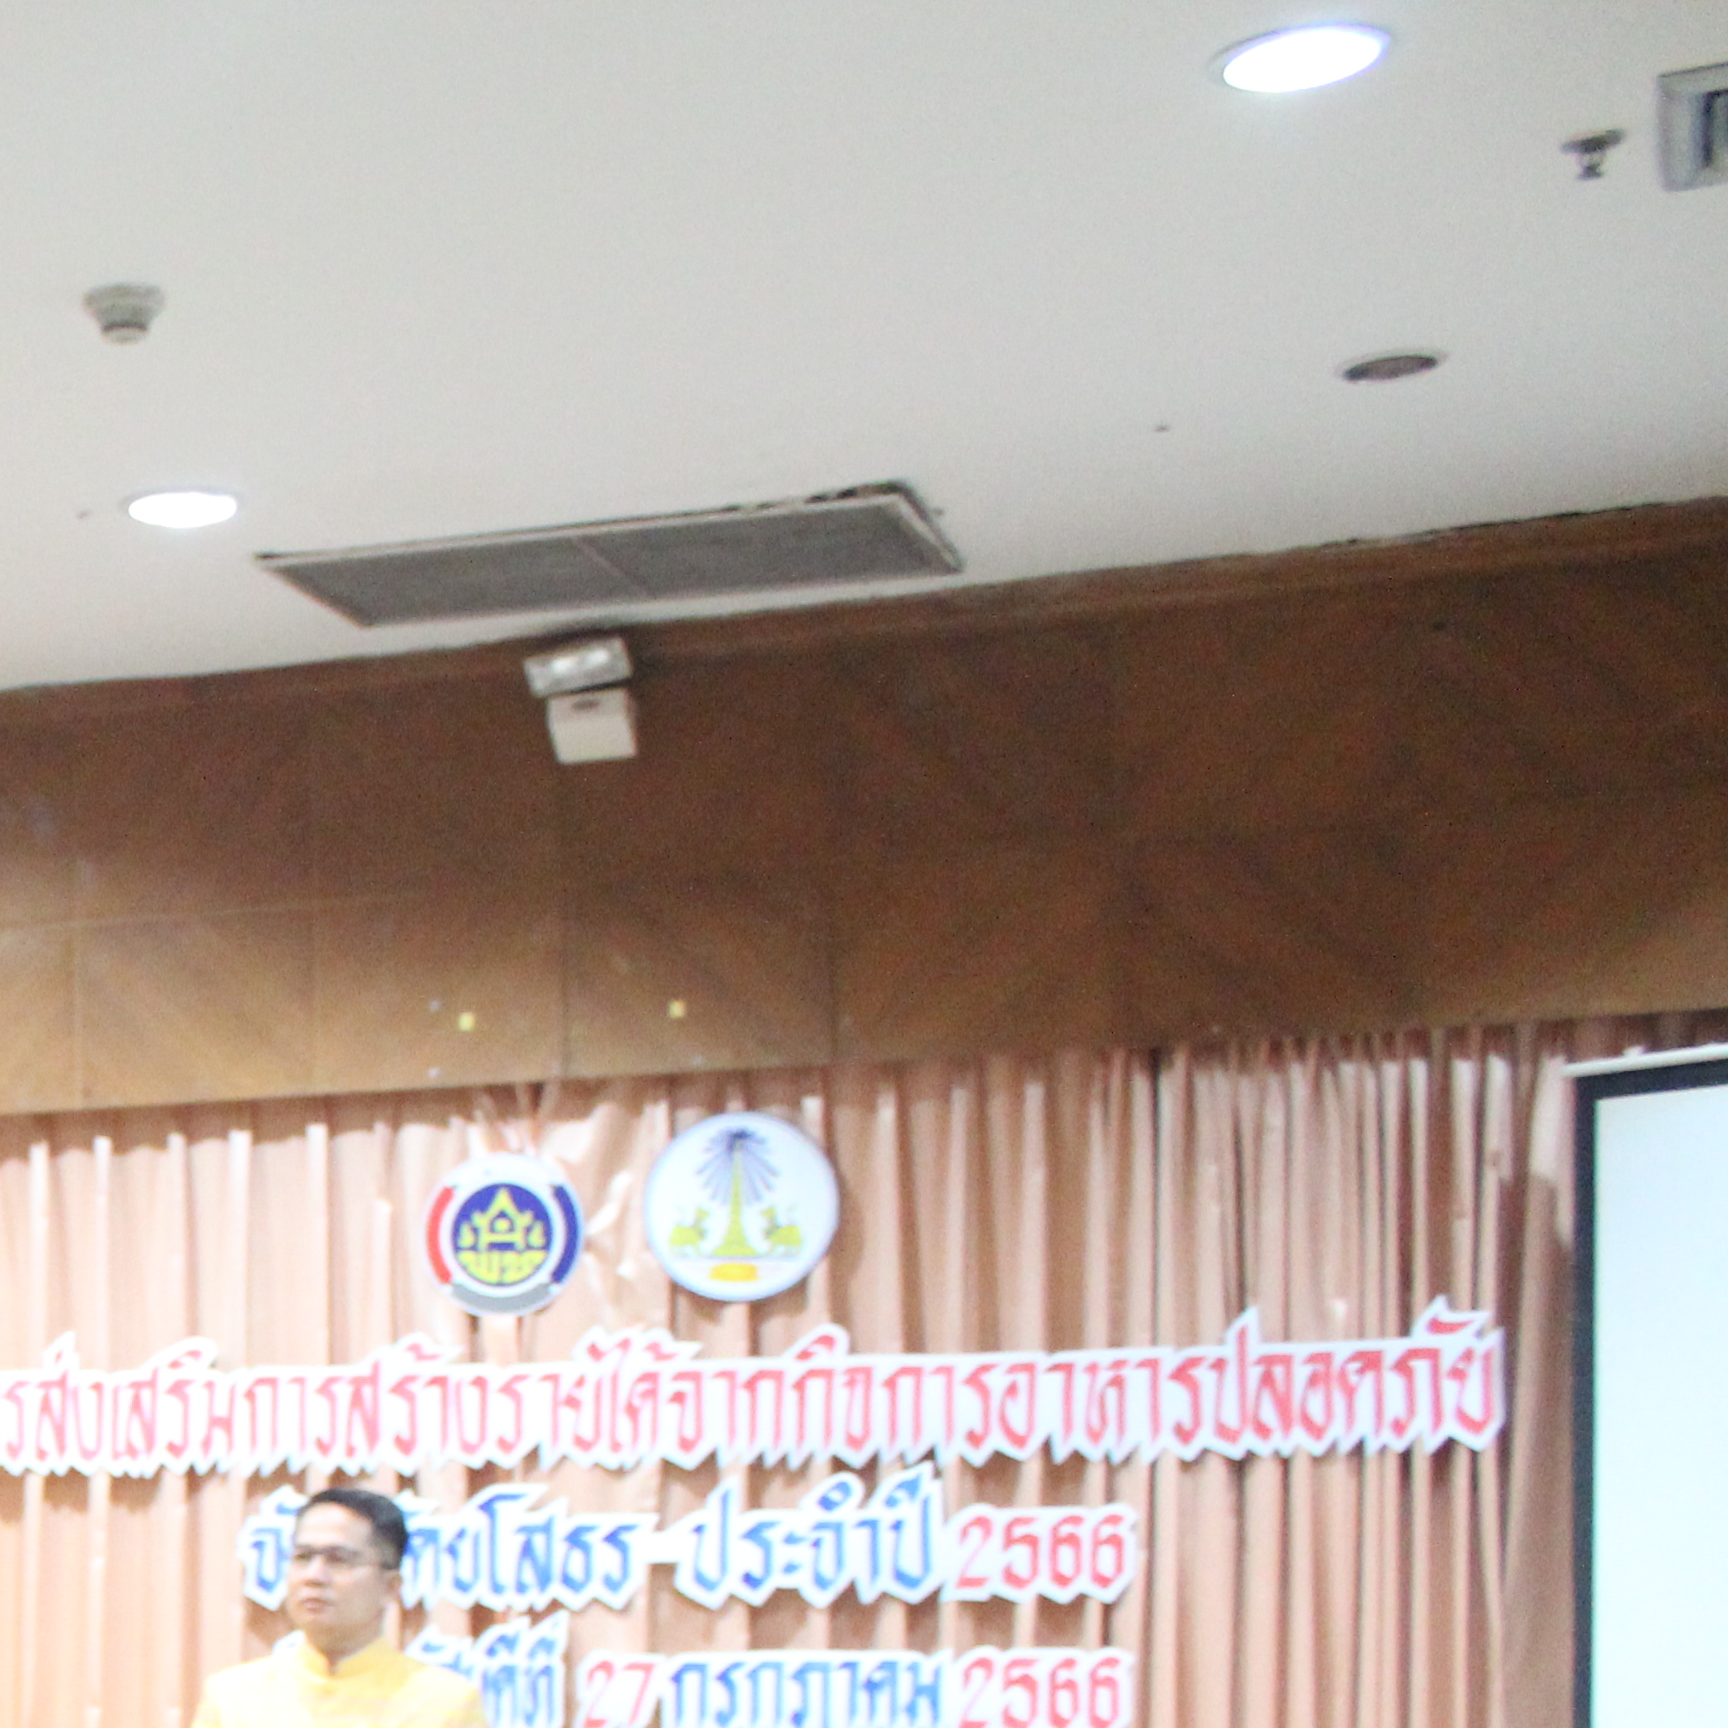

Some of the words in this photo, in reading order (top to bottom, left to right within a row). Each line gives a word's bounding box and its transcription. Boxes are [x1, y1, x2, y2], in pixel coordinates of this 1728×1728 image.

[691, 1476, 939, 1583] ประจำปี
[955, 1510, 1127, 1590] 2566
